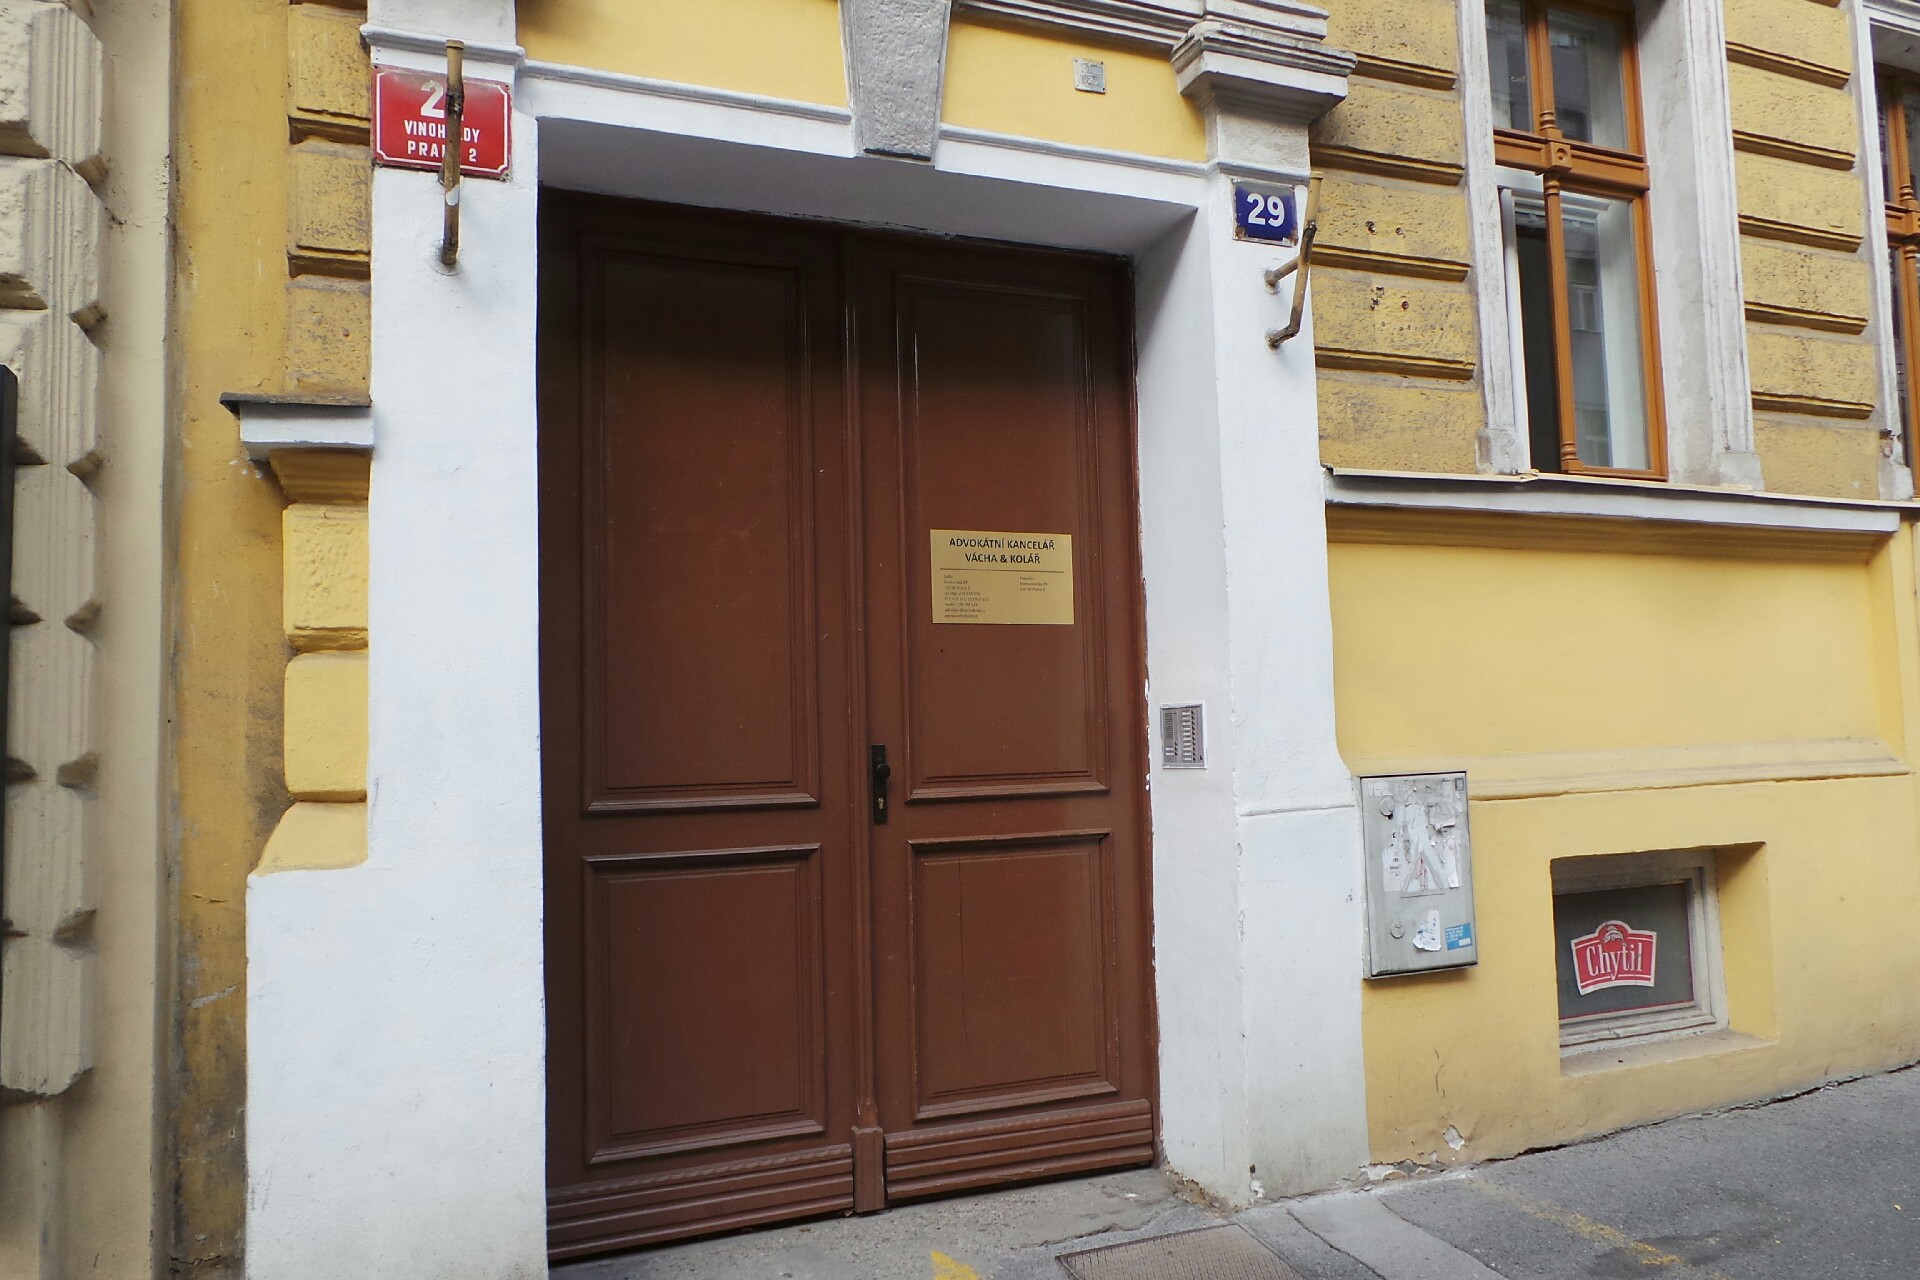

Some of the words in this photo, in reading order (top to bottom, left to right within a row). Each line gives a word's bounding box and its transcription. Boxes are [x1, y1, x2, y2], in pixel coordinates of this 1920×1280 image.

[404, 119, 480, 143] VINOHDY
[407, 140, 449, 160] PRA
[468, 148, 477, 162] 2
[1246, 193, 1285, 227] 29
[949, 537, 1005, 549] ADVOKÁTNÍ
[1007, 539, 1055, 551] KANCELÁŘ
[965, 552, 998, 563] VÁCHA
[1000, 555, 1008, 564] &
[1010, 553, 1041, 564] KOLÁŘ
[1586, 942, 1642, 981] Chytil
